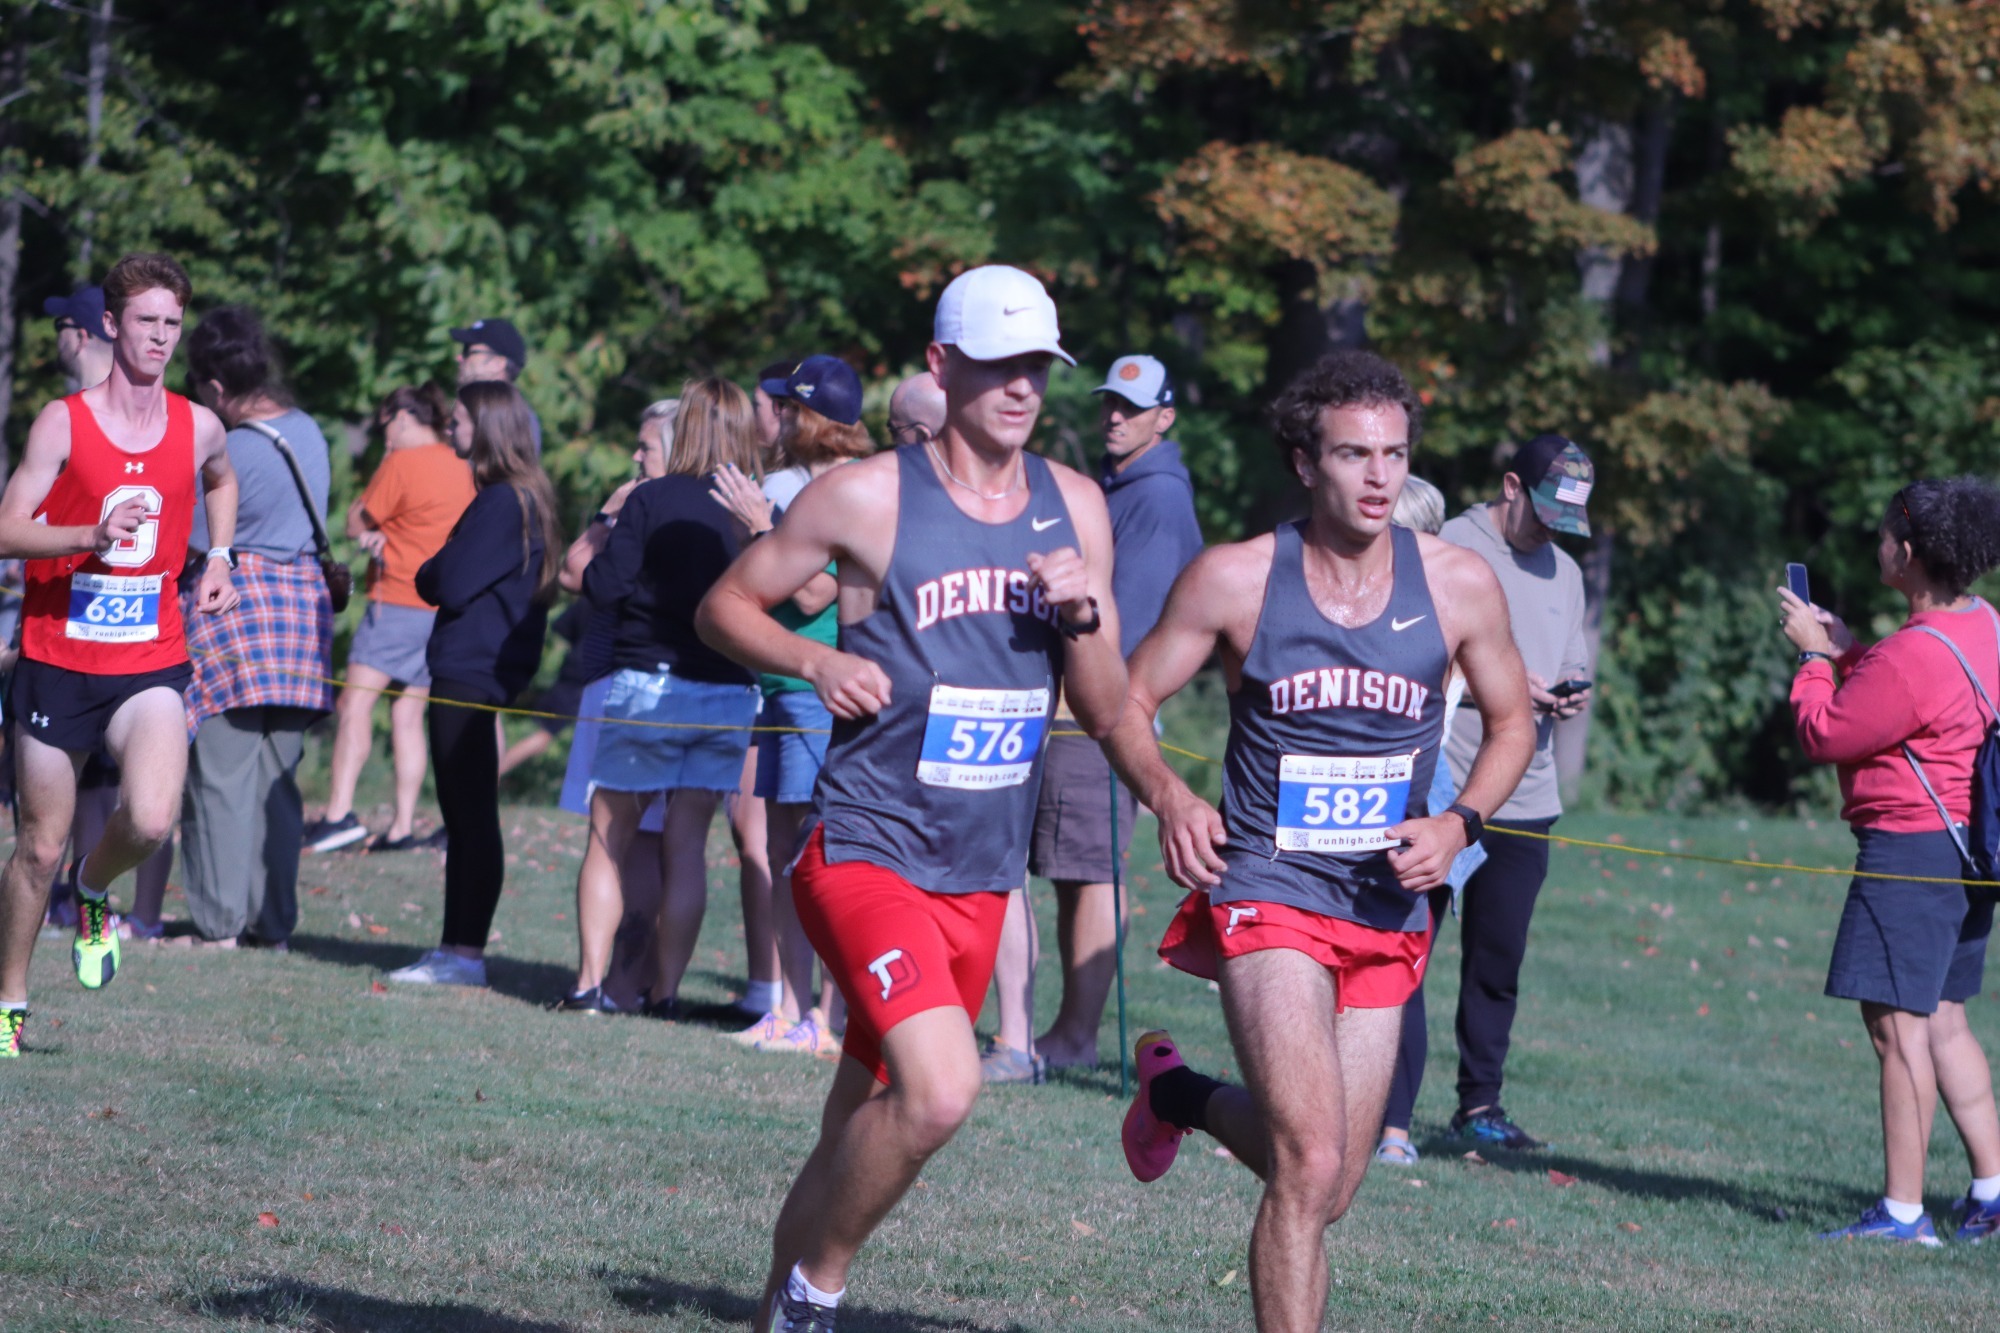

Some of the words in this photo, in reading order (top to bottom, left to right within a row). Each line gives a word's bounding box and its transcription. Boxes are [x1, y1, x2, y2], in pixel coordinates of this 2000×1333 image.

[85, 595, 145, 624] 634
[916, 568, 1060, 629] DENISO
[1269, 667, 1429, 721] DENISON
[946, 719, 1026, 762] 576
[958, 771, 1019, 784] runhigh.com
[1302, 787, 1388, 826] 582
